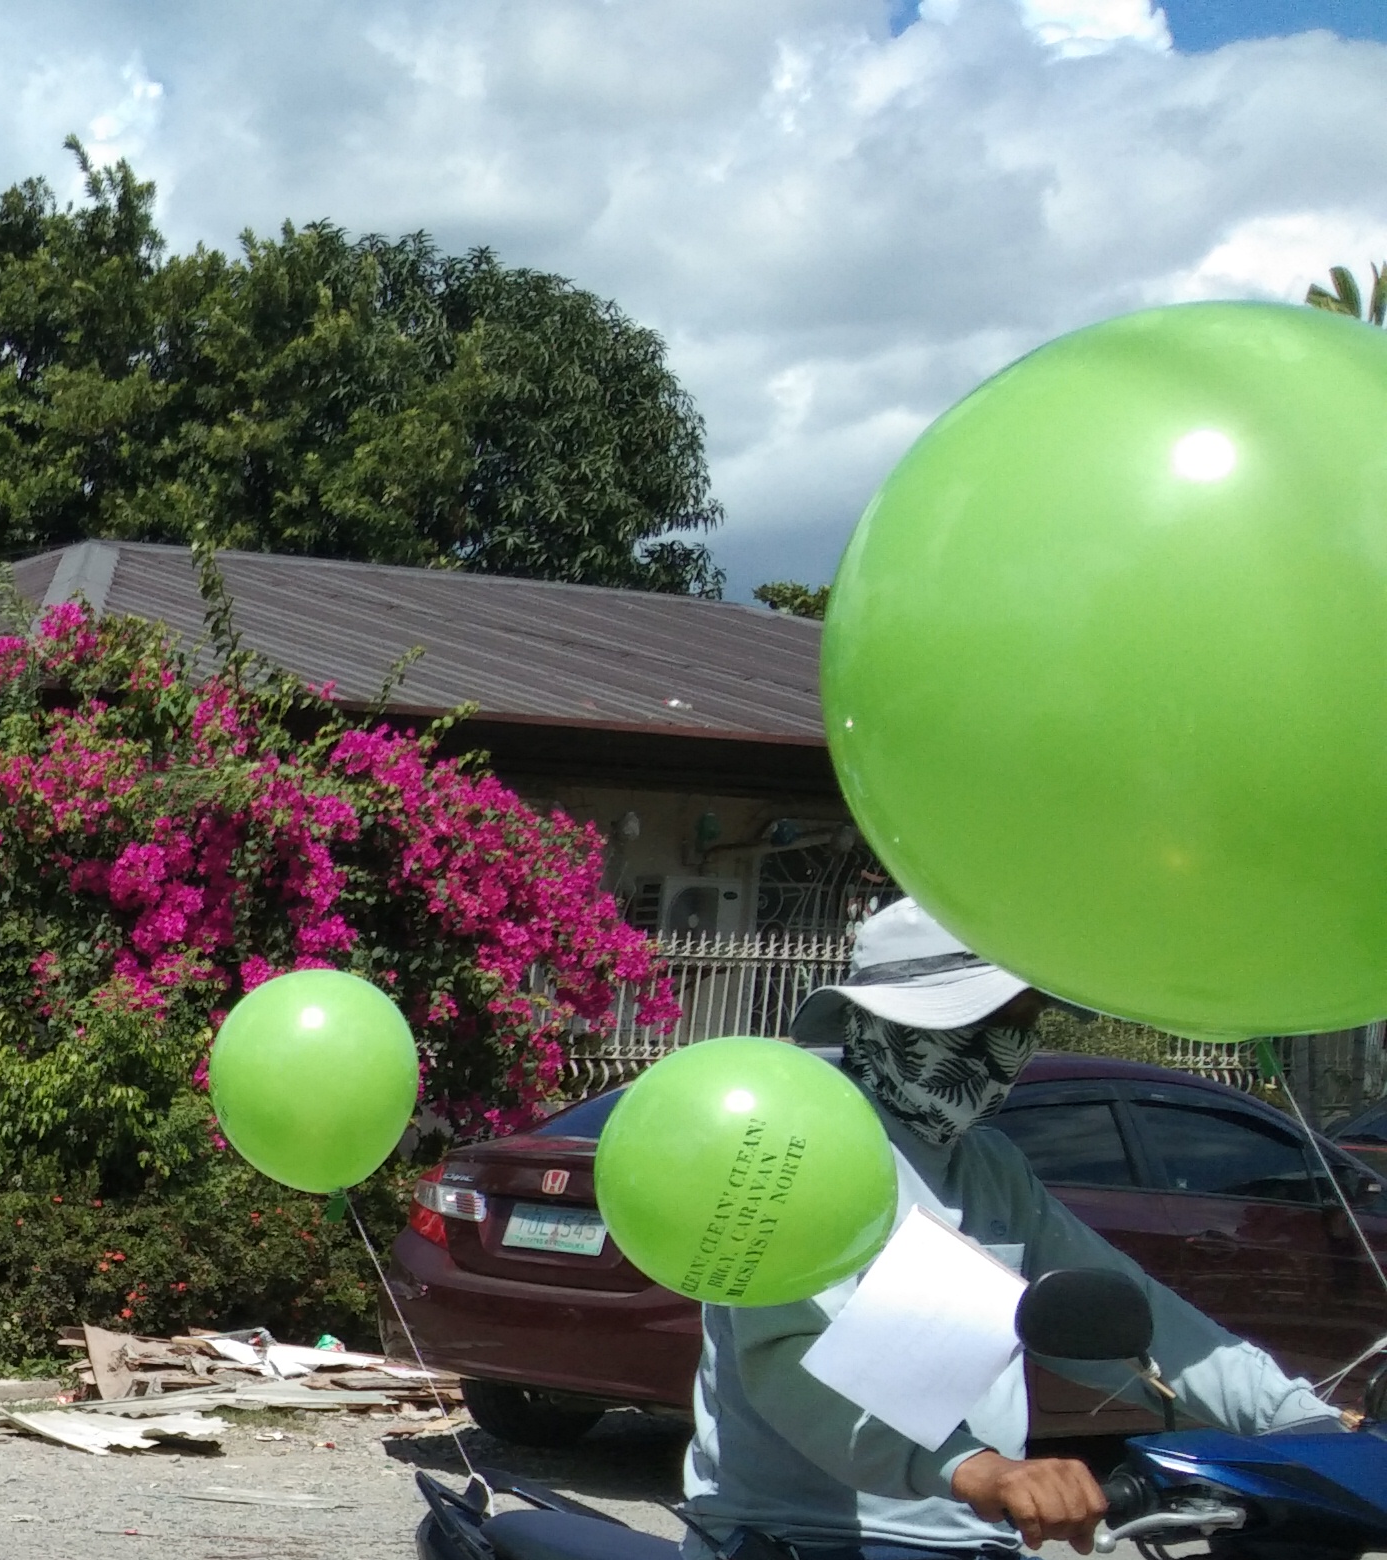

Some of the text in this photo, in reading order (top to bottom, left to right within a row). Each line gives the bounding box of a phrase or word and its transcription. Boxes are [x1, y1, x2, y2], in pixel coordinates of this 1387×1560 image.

[681, 1118, 767, 1293] CLEAN! CLEAN! CLEAN!
[707, 1152, 778, 1288] BRGY. CARAVAN
[725, 1135, 807, 1298] MAGSAYSAY NORTE
